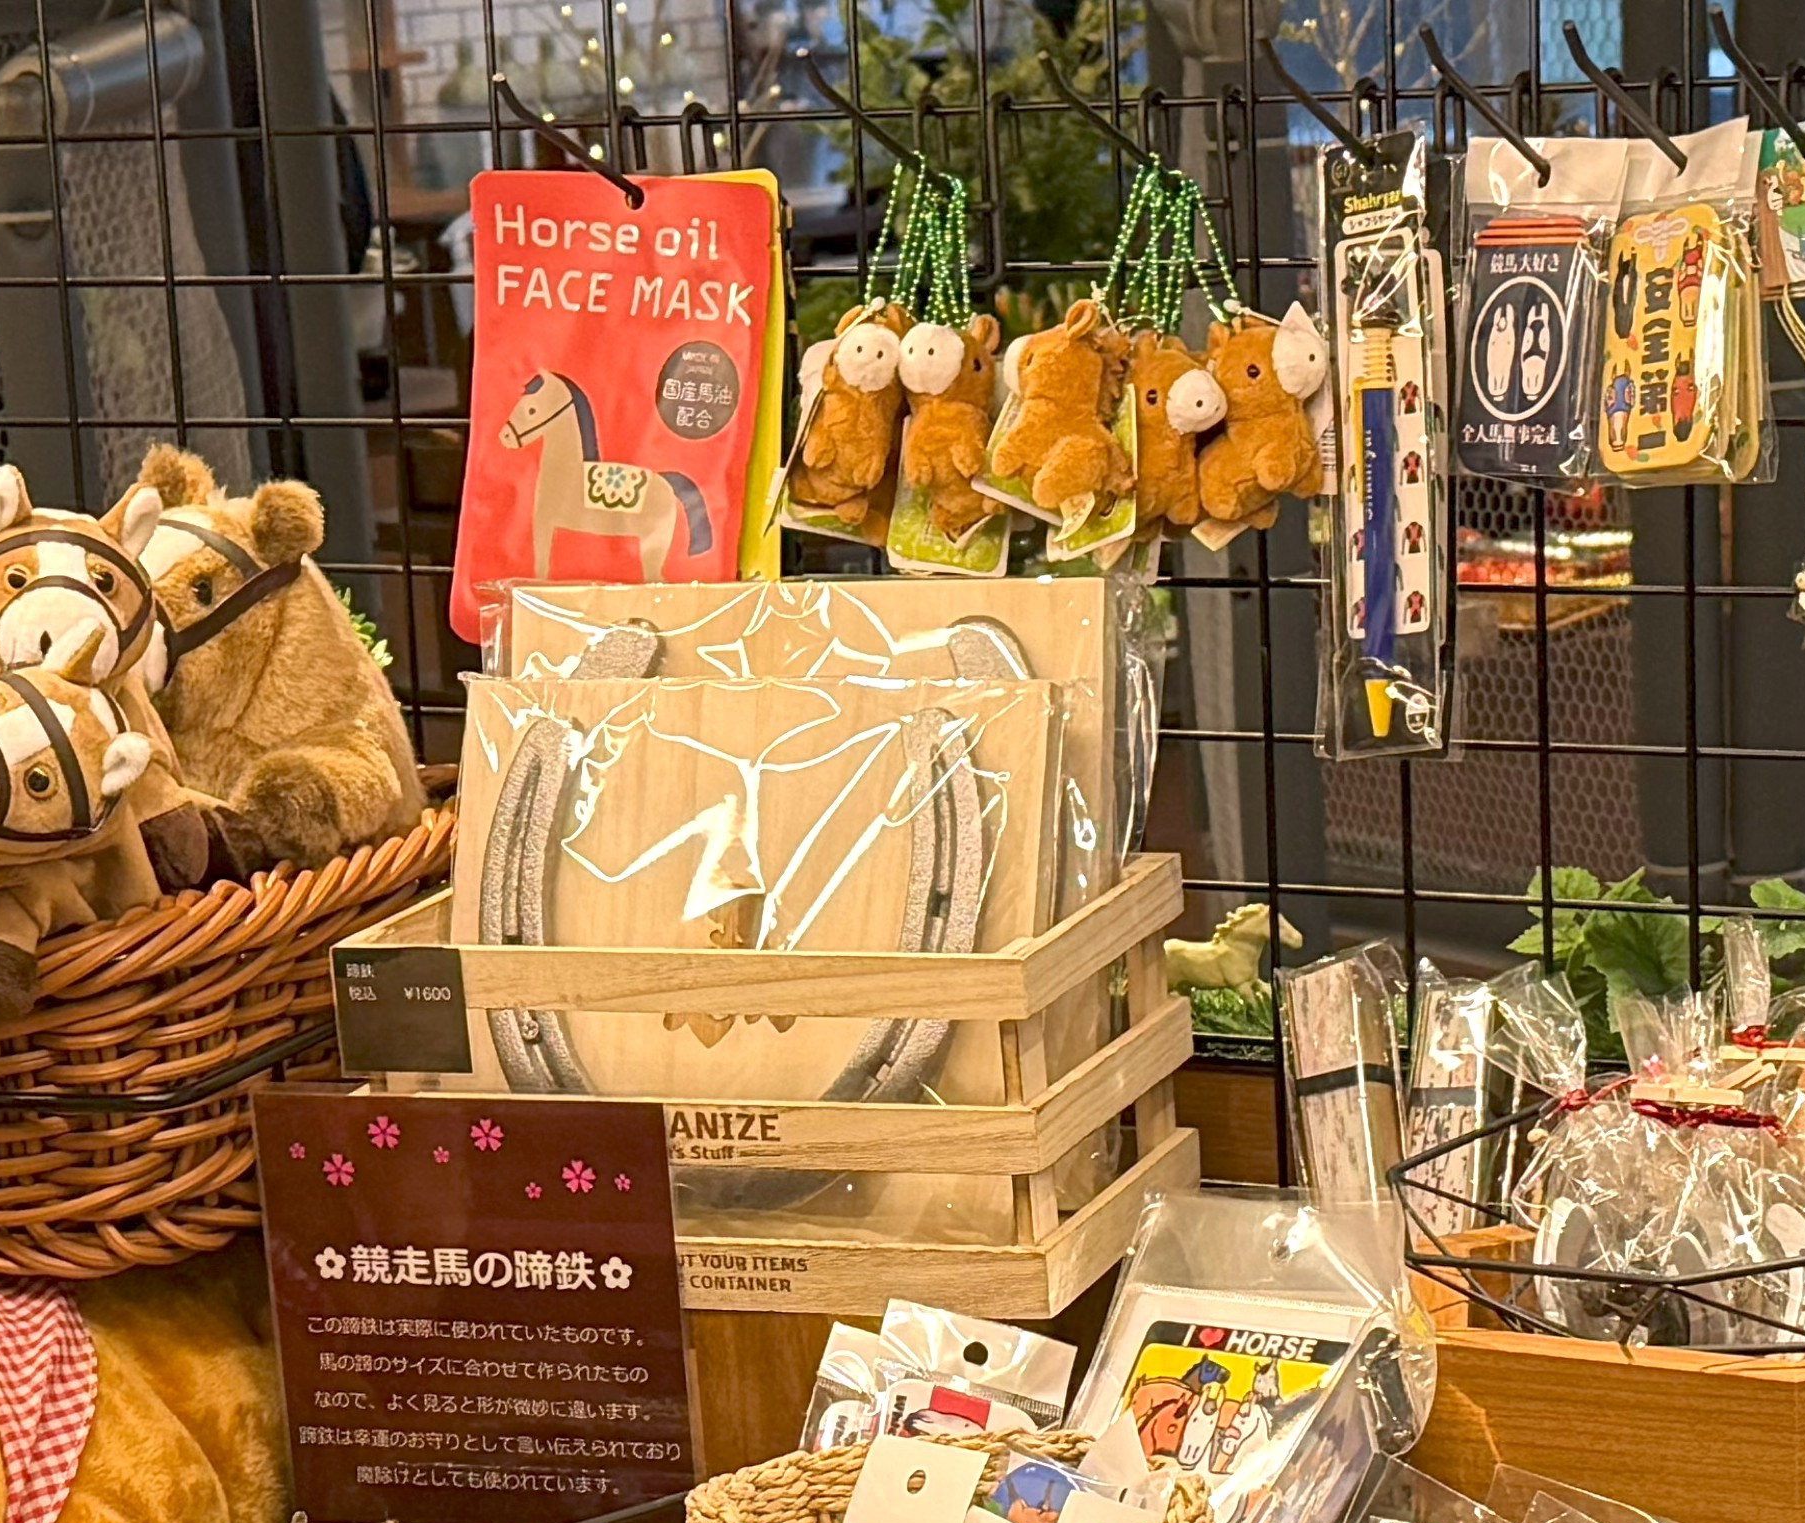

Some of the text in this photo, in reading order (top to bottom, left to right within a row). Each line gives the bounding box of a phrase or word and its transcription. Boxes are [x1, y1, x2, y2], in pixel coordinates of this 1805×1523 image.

[494, 203, 719, 261] Horse oil
[1489, 252, 1561, 275] 競馬大好き
[497, 264, 755, 327] FACE MASK
[1637, 266, 1675, 450] 安全第一
[662, 378, 733, 406] 国産馬油
[676, 404, 714, 430] 配合
[1460, 423, 1561, 446] 全人馬無事完走
[346, 962, 375, 979] 蹄鉄
[348, 986, 452, 1002] 税込 ¥1600
[689, 1144, 736, 1161] Stuff
[350, 1243, 598, 1292] 競走馬の蹄鉄
[699, 1253, 748, 1272] YOUR
[752, 1256, 809, 1273] ITEMS
[688, 1273, 792, 1293] CONTAINER
[305, 1315, 645, 1348] この蹄鉄は実際に使われていたものです。
[1181, 1324, 1319, 1363] I HORSE
[318, 1351, 649, 1383] 馬の蹄のサイズに合わせて作られたもの
[313, 1390, 652, 1422] なので、よく見ると形が微妙に違います。
[298, 1424, 682, 1462] 蹄鉄は幸運のお守りとして言い伝えられており
[356, 1464, 621, 1496] 魔除けとしても使われています。
